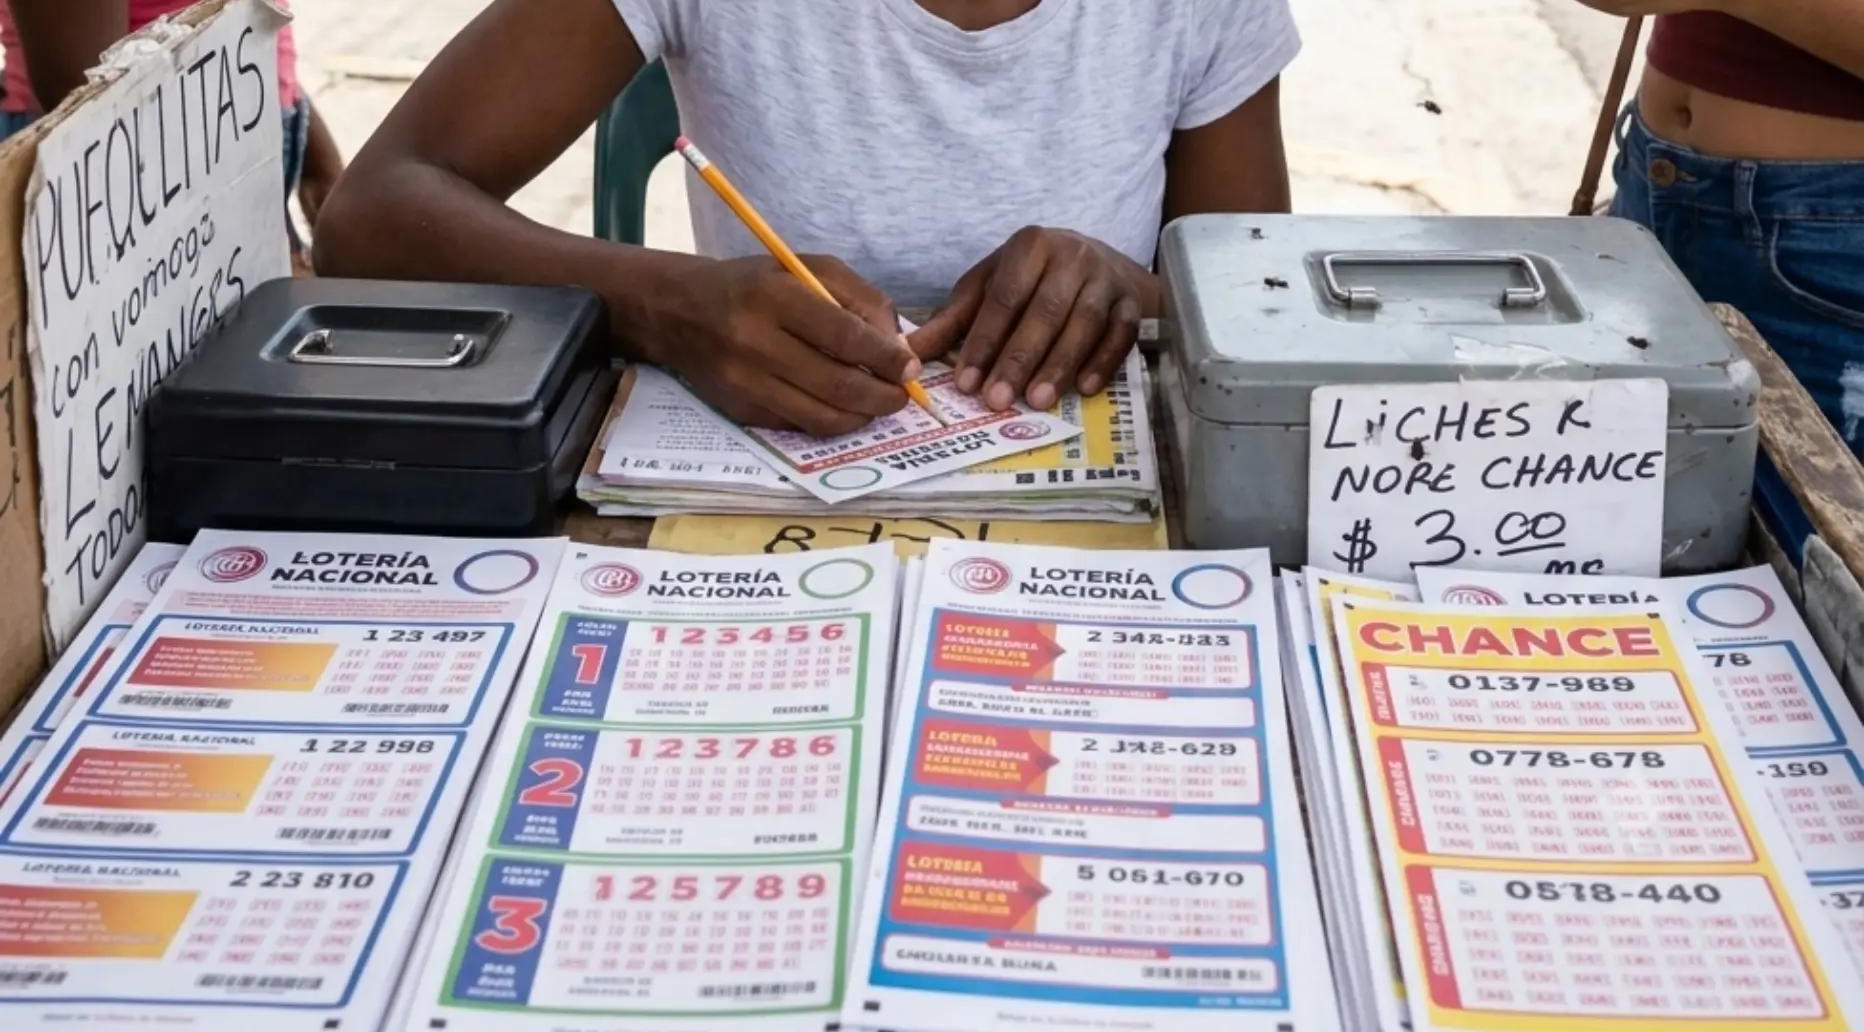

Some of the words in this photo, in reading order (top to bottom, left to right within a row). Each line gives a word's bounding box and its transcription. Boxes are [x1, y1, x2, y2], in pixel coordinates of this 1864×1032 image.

[1481, 450, 1664, 490] CHANCE
[1332, 518, 1378, 573] $
[291, 550, 431, 569] LOTERÍA
[270, 567, 440, 587] NACIONAL
[660, 569, 782, 584] LOTERÍA
[1030, 566, 1155, 586] LOTERÍA
[647, 584, 792, 599] NACIONAL
[1018, 581, 1167, 602] NACIONAL
[1358, 621, 1661, 658] CHANCE
[572, 643, 606, 685] 1
[519, 757, 583, 808] 2
[229, 870, 252, 888] 2
[259, 870, 304, 889] 23
[475, 895, 549, 956] 3
